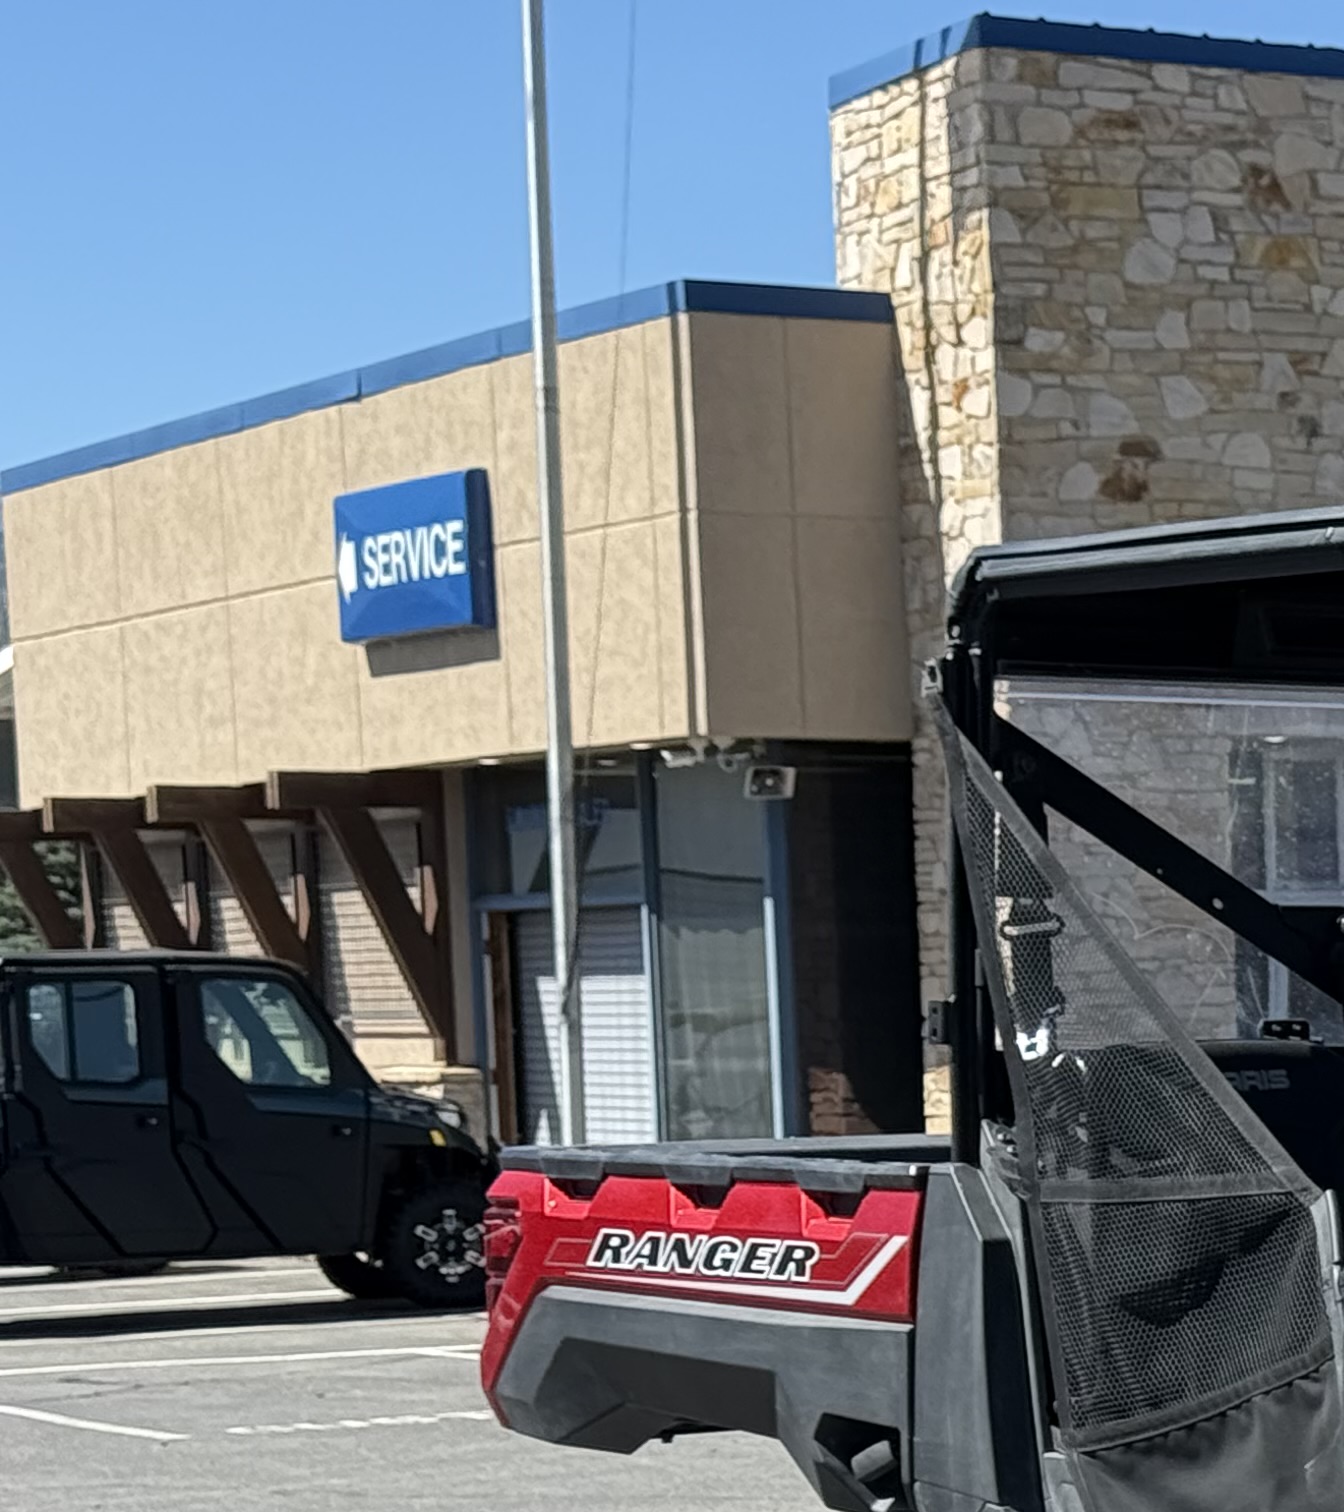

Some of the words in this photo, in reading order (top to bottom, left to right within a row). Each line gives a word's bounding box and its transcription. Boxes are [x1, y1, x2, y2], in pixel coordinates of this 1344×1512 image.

[363, 519, 467, 590] SERVICE
[1223, 1068, 1292, 1092] ARIS
[586, 1227, 821, 1282] RANGER
